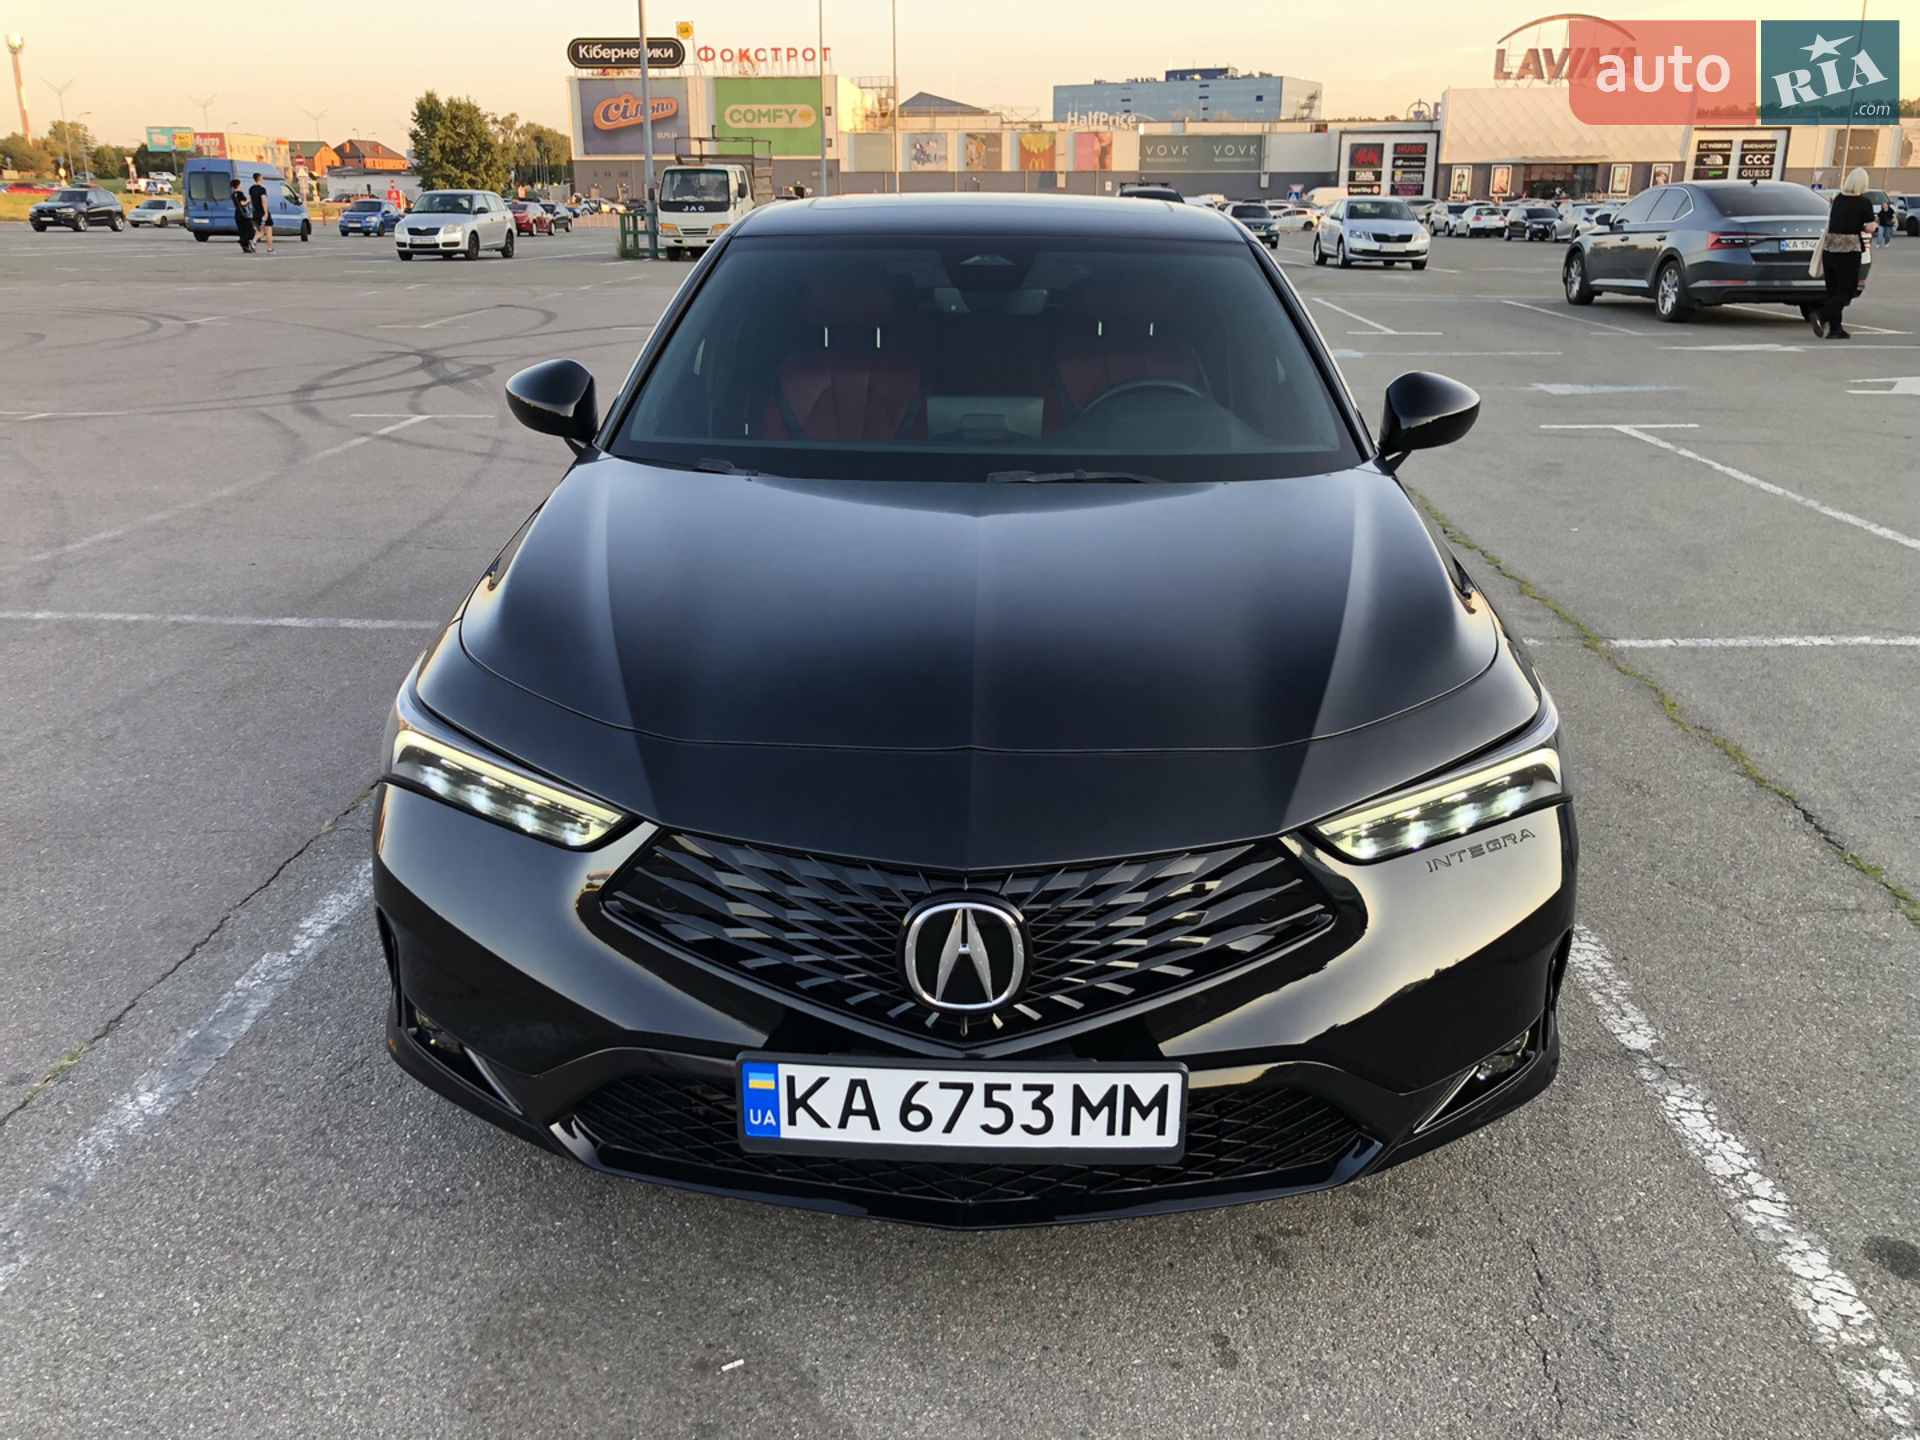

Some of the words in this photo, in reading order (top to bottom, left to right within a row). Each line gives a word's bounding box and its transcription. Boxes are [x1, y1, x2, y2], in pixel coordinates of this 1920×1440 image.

[578, 44, 674, 63] Кібернеики
[696, 45, 831, 63] ФОКСТРОТ
[728, 108, 798, 124] COMFY
[1067, 111, 1137, 126] HalfPrice
[1145, 144, 1189, 156] VOVK
[1213, 144, 1257, 156] VOVK
[1397, 145, 1426, 154] HUGO
[1745, 155, 1770, 165] CCC
[1741, 169, 1770, 177] GUESS
[1425, 828, 1536, 873] INTEGRA
[785, 1074, 881, 1131] KA
[898, 1081, 1055, 1136] 6753
[1071, 1083, 1169, 1136] MM
[749, 1109, 776, 1126] UA
